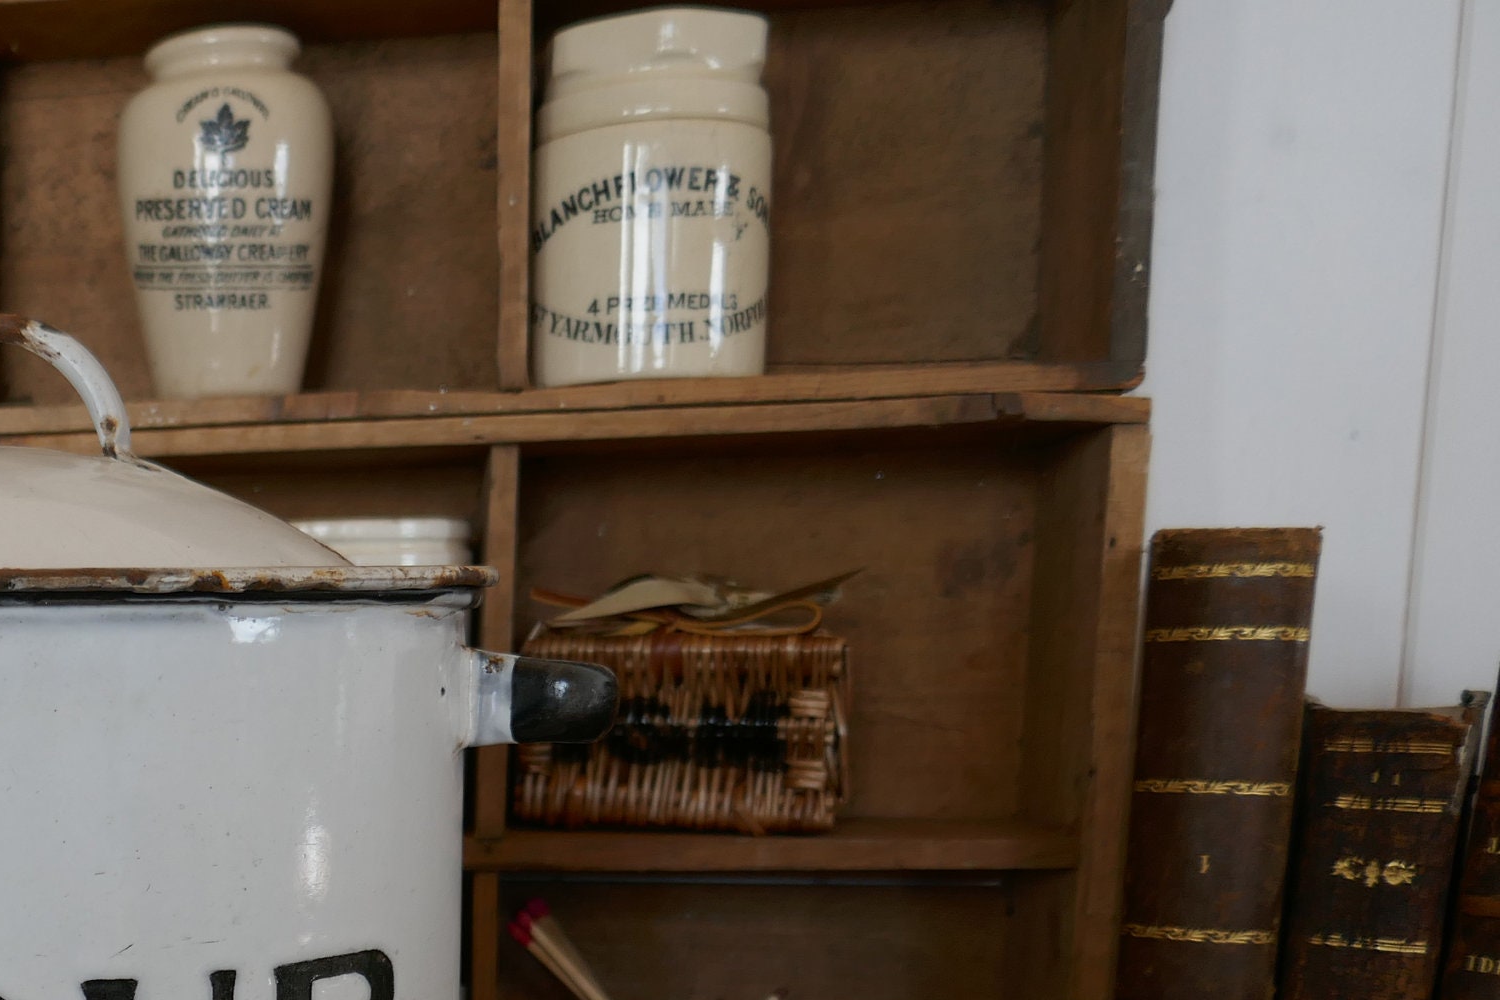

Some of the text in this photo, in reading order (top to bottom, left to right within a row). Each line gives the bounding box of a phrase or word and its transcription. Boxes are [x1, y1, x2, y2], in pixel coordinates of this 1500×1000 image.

[173, 168, 274, 190] DELICIOUS
[135, 197, 312, 222] PRESERVED CREAM
[587, 298, 600, 316] 4
[668, 293, 738, 312] MEDLS
